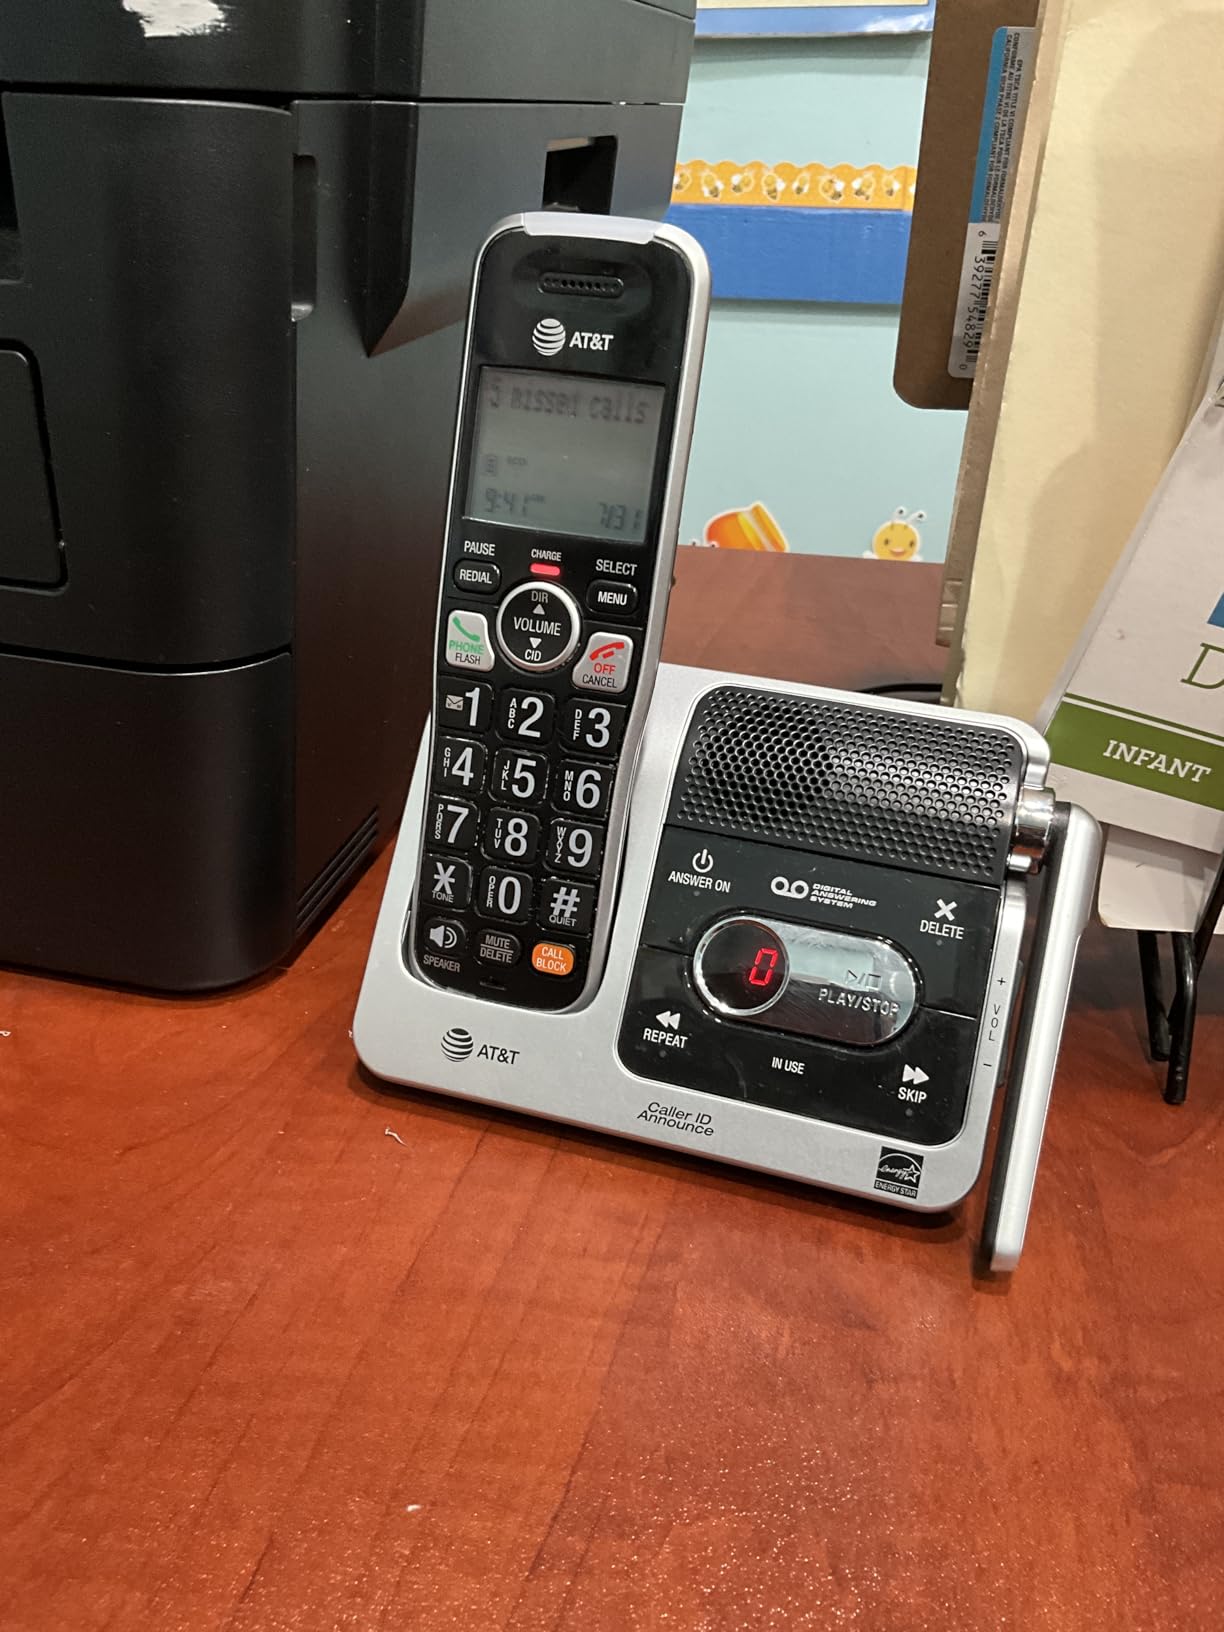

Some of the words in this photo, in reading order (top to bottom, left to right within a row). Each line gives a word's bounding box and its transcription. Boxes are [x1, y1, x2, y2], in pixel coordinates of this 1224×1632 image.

[1002, 33, 1012, 73] CALIFORNIA
[1008, 32, 1019, 69] CONFORME
[1007, 70, 1014, 81] AU
[1012, 73, 1020, 90] TSCA
[1004, 82, 1013, 99] TITRE
[996, 93, 1004, 114] PHASE
[1002, 108, 1009, 117] DE
[1000, 118, 1008, 127] LA
[990, 120, 1000, 158] COMPLIANT
[998, 128, 1006, 145] TSCA
[1004, 118, 1014, 155] COMPLIANT
[969, 256, 985, 299] 39277
[963, 307, 978, 348] 54829
[569, 332, 614, 351] AT&T
[590, 390, 649, 424] calls
[464, 540, 496, 557] PAUSE
[531, 549, 562, 562] CHARGE
[459, 568, 492, 584] REDIAL
[595, 559, 637, 576] SELECT
[531, 590, 549, 603] DIR
[597, 591, 628, 605] MENU
[513, 616, 561, 636] VOLUME
[449, 640, 485, 655] PHONE
[524, 649, 542, 662] CID
[455, 652, 481, 665] FLASH
[593, 663, 616, 675] OFF
[582, 674, 617, 688] CANCEL
[465, 687, 480, 727] 1
[518, 697, 545, 738] 2
[585, 707, 611, 748] 3
[451, 747, 474, 786] 4
[1103, 739, 1212, 784] INFANT
[511, 758, 537, 799] 5
[576, 769, 602, 809] 6
[447, 804, 469, 844] 7
[504, 817, 529, 856] 8
[567, 828, 593, 868] 9
[668, 871, 712, 888] ANSWER
[715, 880, 731, 893] ON
[812, 883, 853, 896] DIGITAL
[432, 890, 454, 903] TONE
[498, 876, 521, 914] 0
[550, 886, 580, 917] #
[809, 895, 854, 909] SYSTEM
[811, 889, 877, 907] ANSWERING
[549, 914, 577, 927] QUIET
[920, 919, 964, 940] DELETE
[485, 934, 511, 948] MUTE
[480, 947, 514, 963] DELETE
[541, 946, 564, 960] CALL
[423, 954, 460, 972] SPEAKER
[536, 957, 567, 972] BLOCK
[749, 948, 778, 986] 0
[818, 988, 899, 1016] PLAY/STOP
[988, 1004, 1001, 1042] VOL
[643, 1028, 688, 1049] REPEAT
[477, 1044, 520, 1065] AT&T
[772, 1057, 782, 1069] IN
[784, 1060, 805, 1075] USE
[898, 1087, 927, 1103] SKIP
[647, 1101, 693, 1121] Caller
[694, 1112, 712, 1125] ID
[637, 1110, 714, 1136] Announce
[875, 1180, 900, 1192] ENERGY
[900, 1187, 917, 1197] STAR
